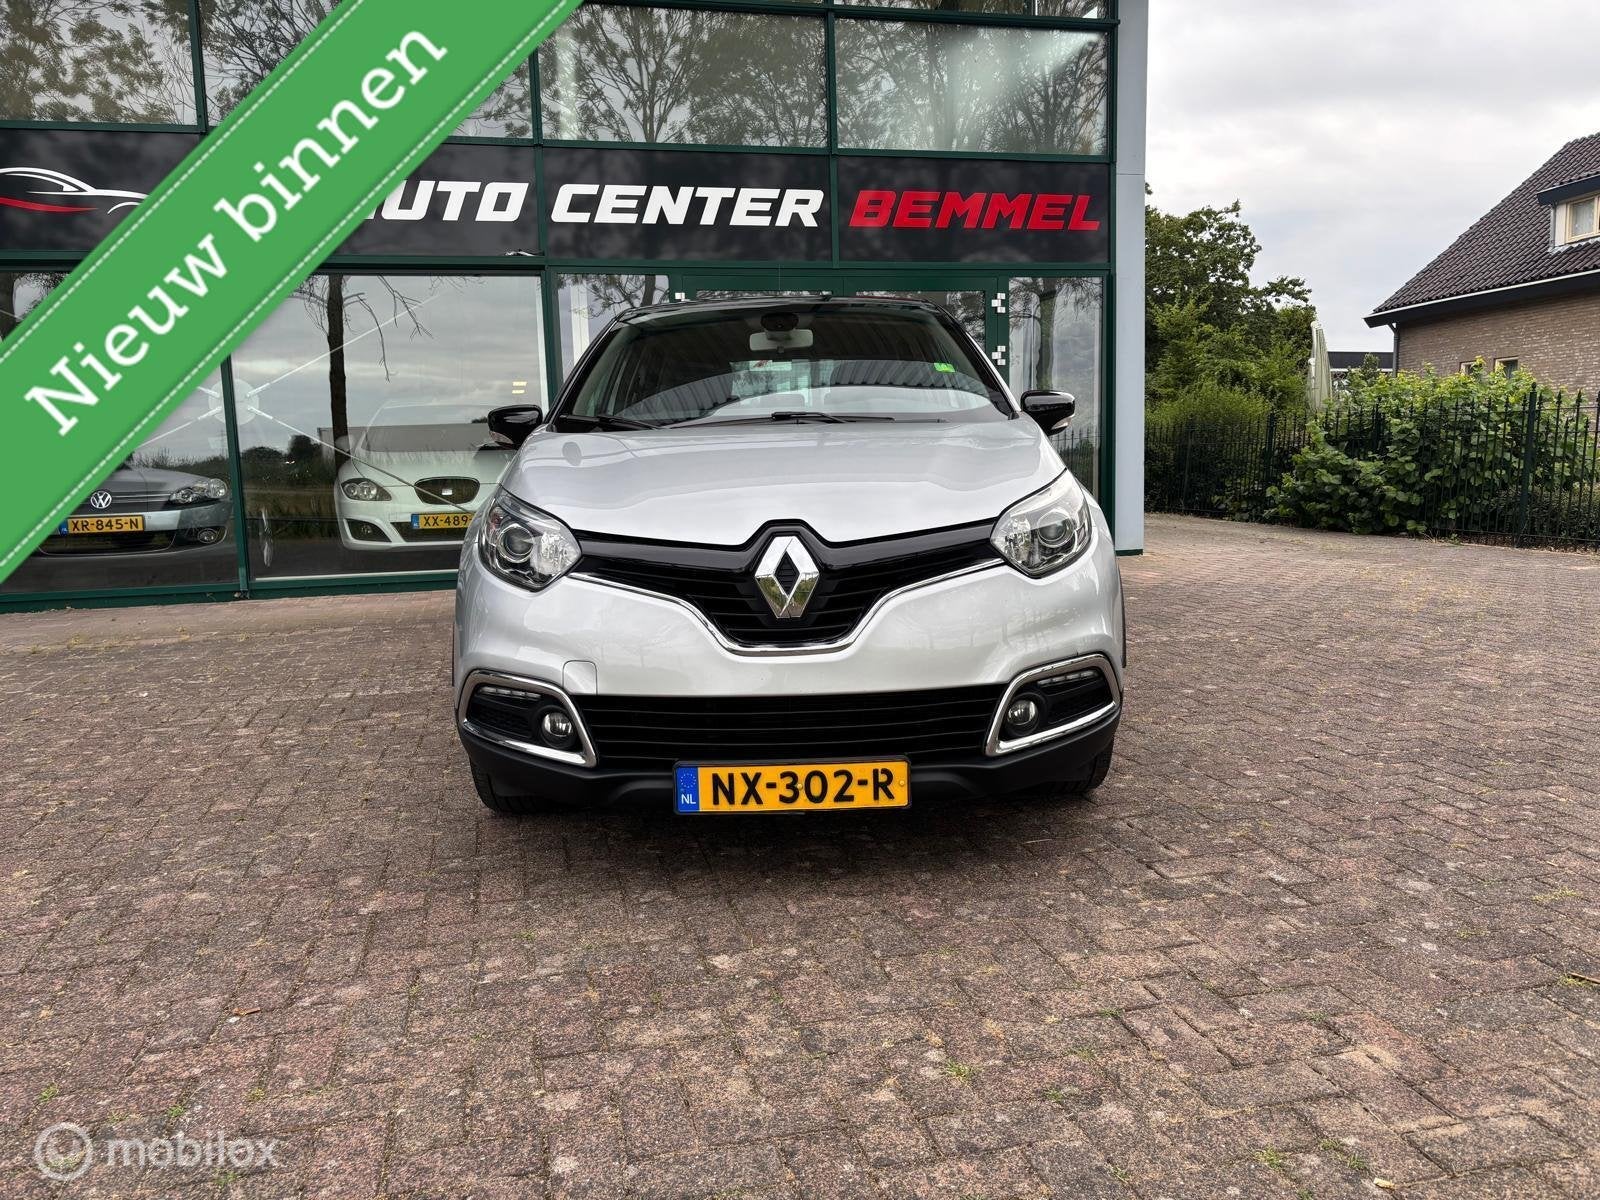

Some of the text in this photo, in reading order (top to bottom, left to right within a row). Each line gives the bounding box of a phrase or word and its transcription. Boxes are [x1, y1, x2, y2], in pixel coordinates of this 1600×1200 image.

[364, 179, 1101, 231] UTO CENTER BEMMEL
[71, 518, 139, 532] XR-845-N
[681, 767, 895, 806] NL NX-302-R
